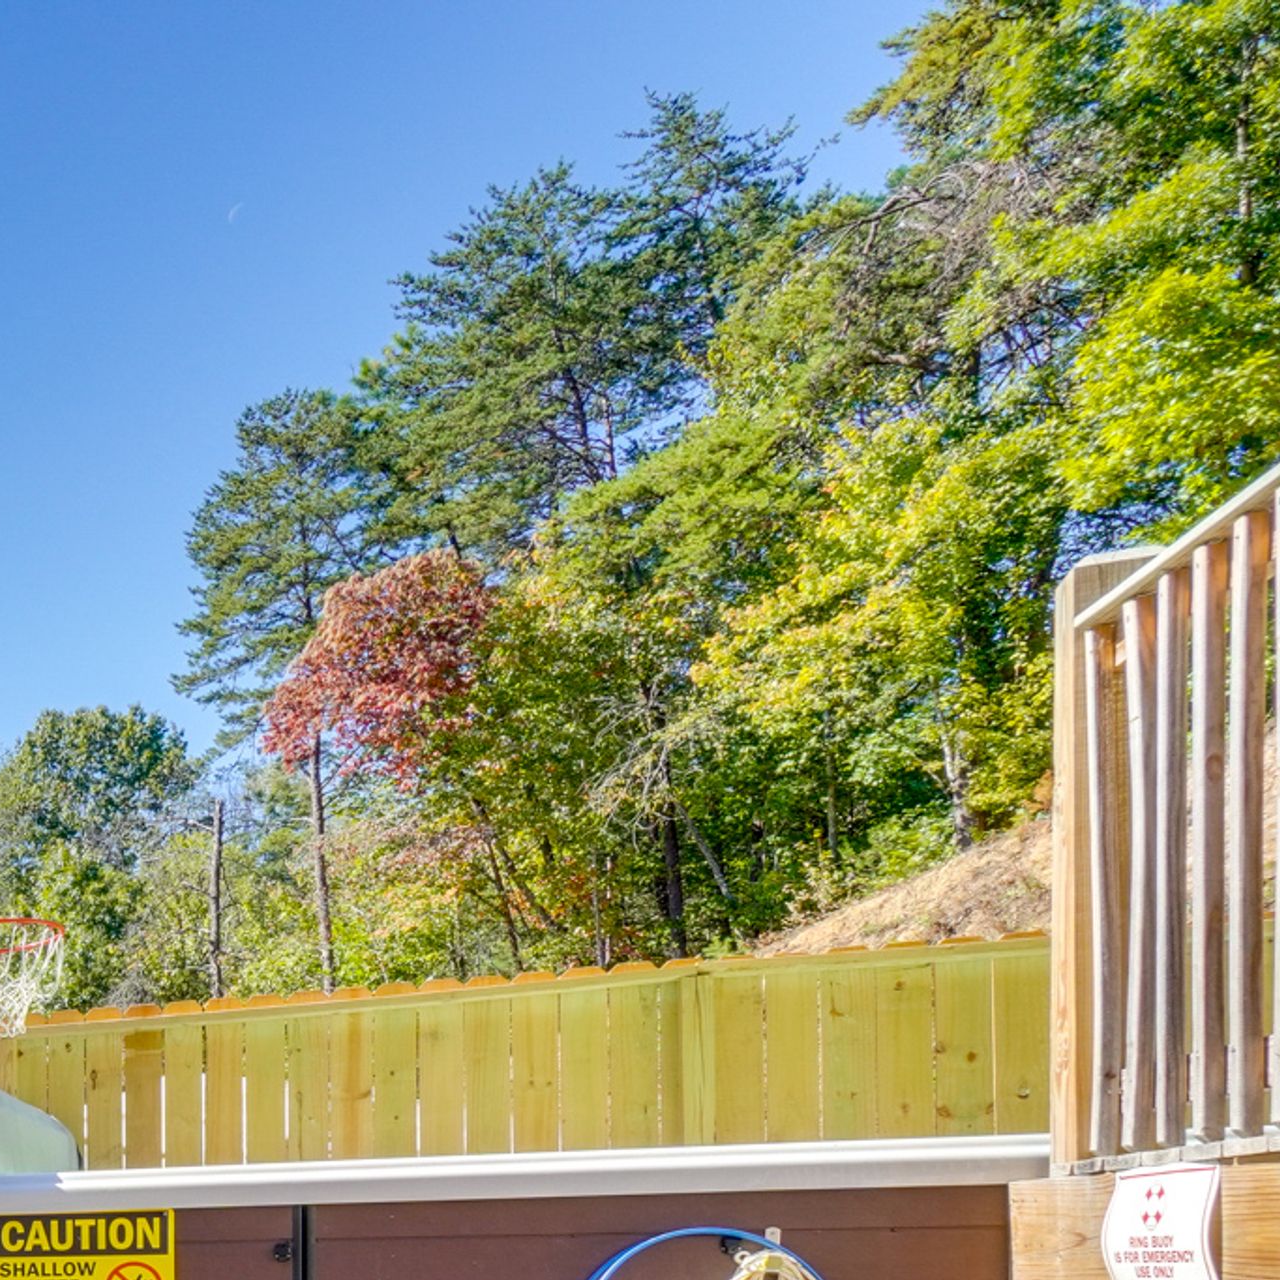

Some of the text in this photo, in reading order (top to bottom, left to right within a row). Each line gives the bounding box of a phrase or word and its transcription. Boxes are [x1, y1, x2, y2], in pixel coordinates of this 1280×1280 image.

[1, 1217, 161, 1252] CAUTION
[1128, 1235, 1174, 1248] RING BUOY
[1123, 1251, 1140, 1263] FOR
[1142, 1250, 1195, 1263] EMERGENCY
[0, 1262, 96, 1278] SHALLOW
[1134, 1266, 1174, 1278] USE ONLY
